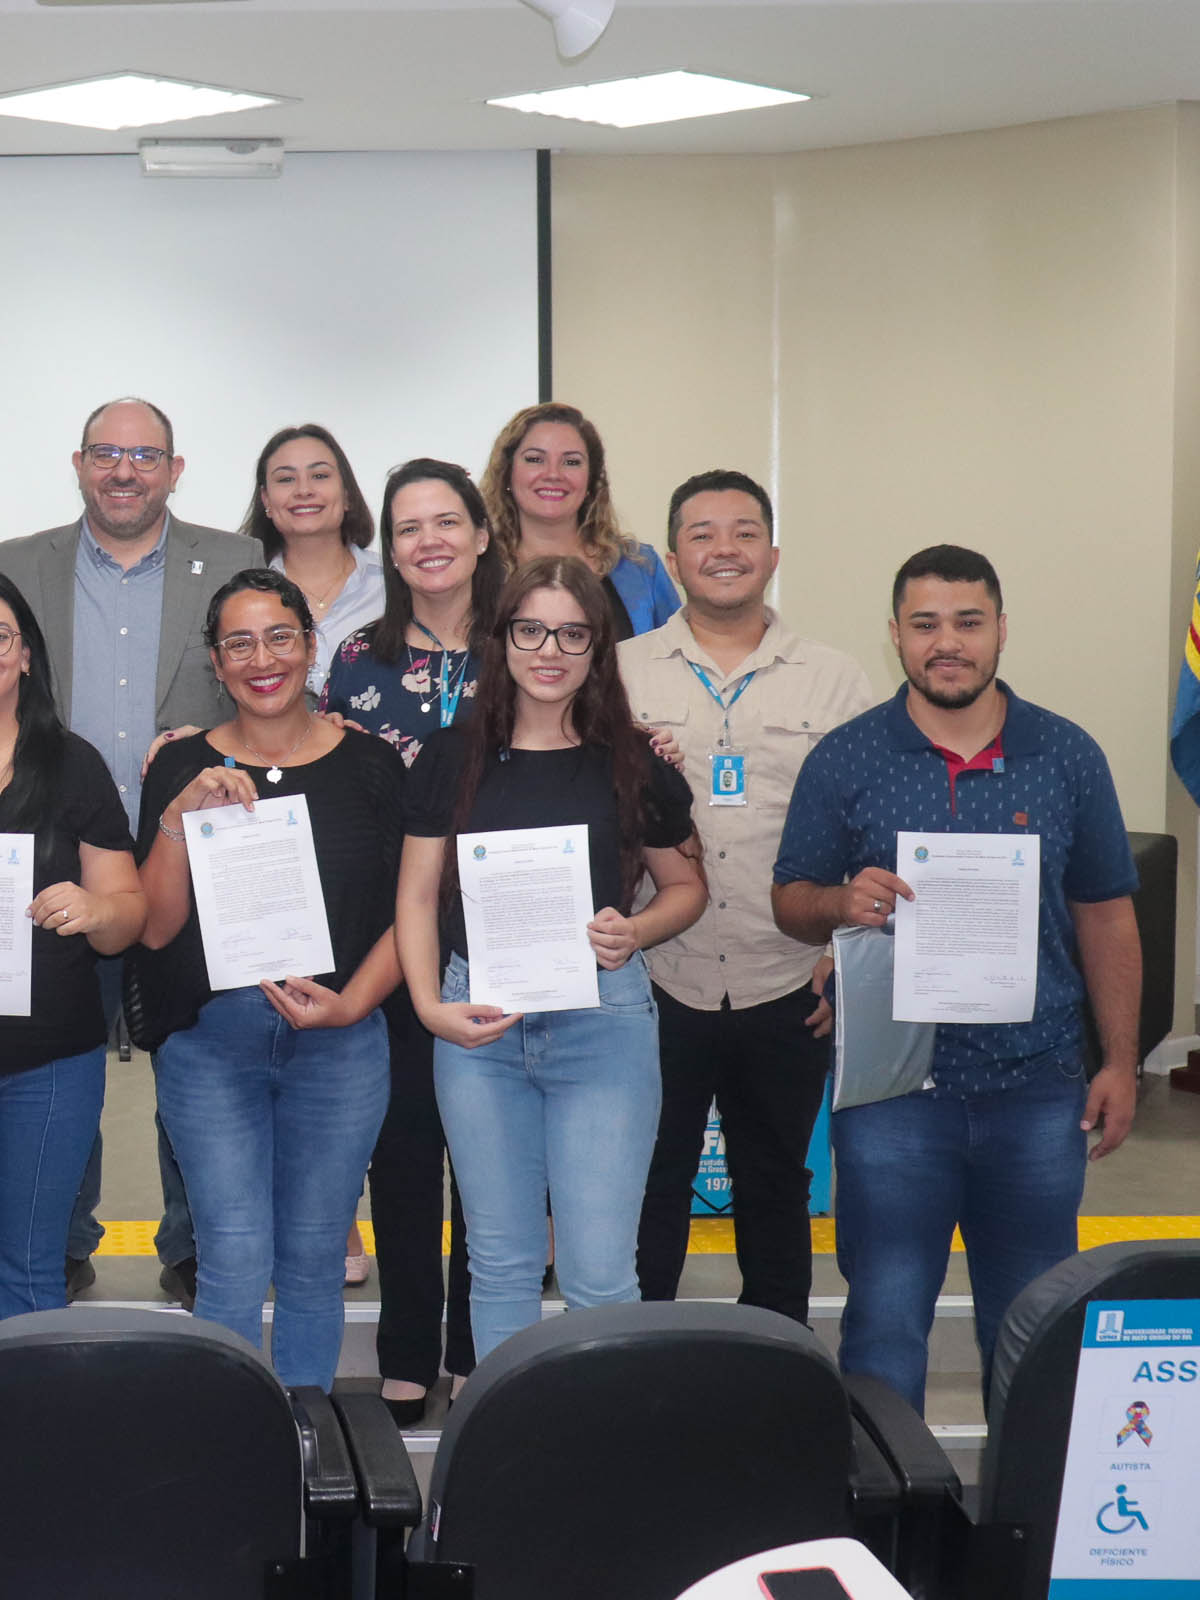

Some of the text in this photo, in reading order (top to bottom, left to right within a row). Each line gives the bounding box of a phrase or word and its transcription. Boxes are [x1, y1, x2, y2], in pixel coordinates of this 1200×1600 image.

[1110, 1463, 1151, 1471] AUTISTA
[1089, 1548, 1148, 1557] DEFICIENTE
[1100, 1556, 1134, 1567] FÍSICO
